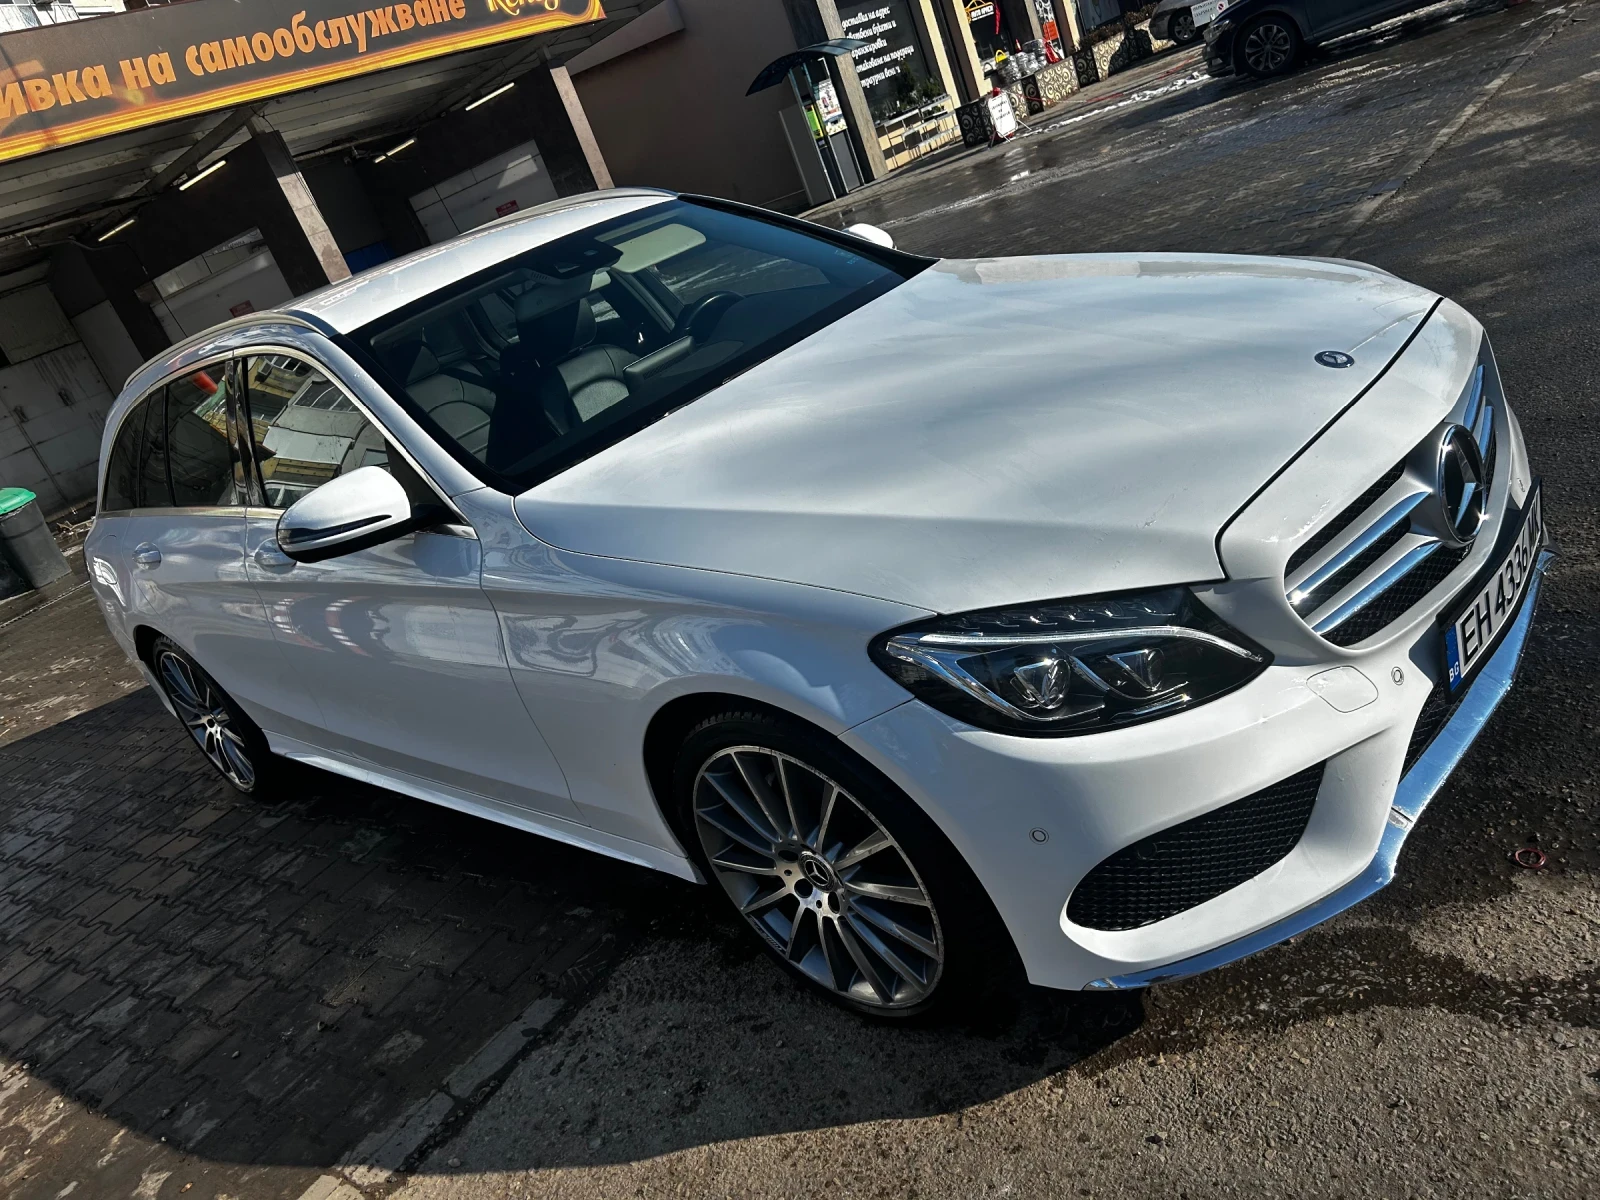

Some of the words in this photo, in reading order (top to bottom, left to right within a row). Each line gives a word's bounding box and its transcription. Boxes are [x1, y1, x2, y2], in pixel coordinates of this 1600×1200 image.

[867, 10, 876, 20] на
[119, 51, 177, 88] на
[185, 0, 468, 77] самообслужване
[1461, 587, 1494, 666] EH
[1494, 528, 1529, 618] 4336
[1449, 661, 1461, 683] BG
